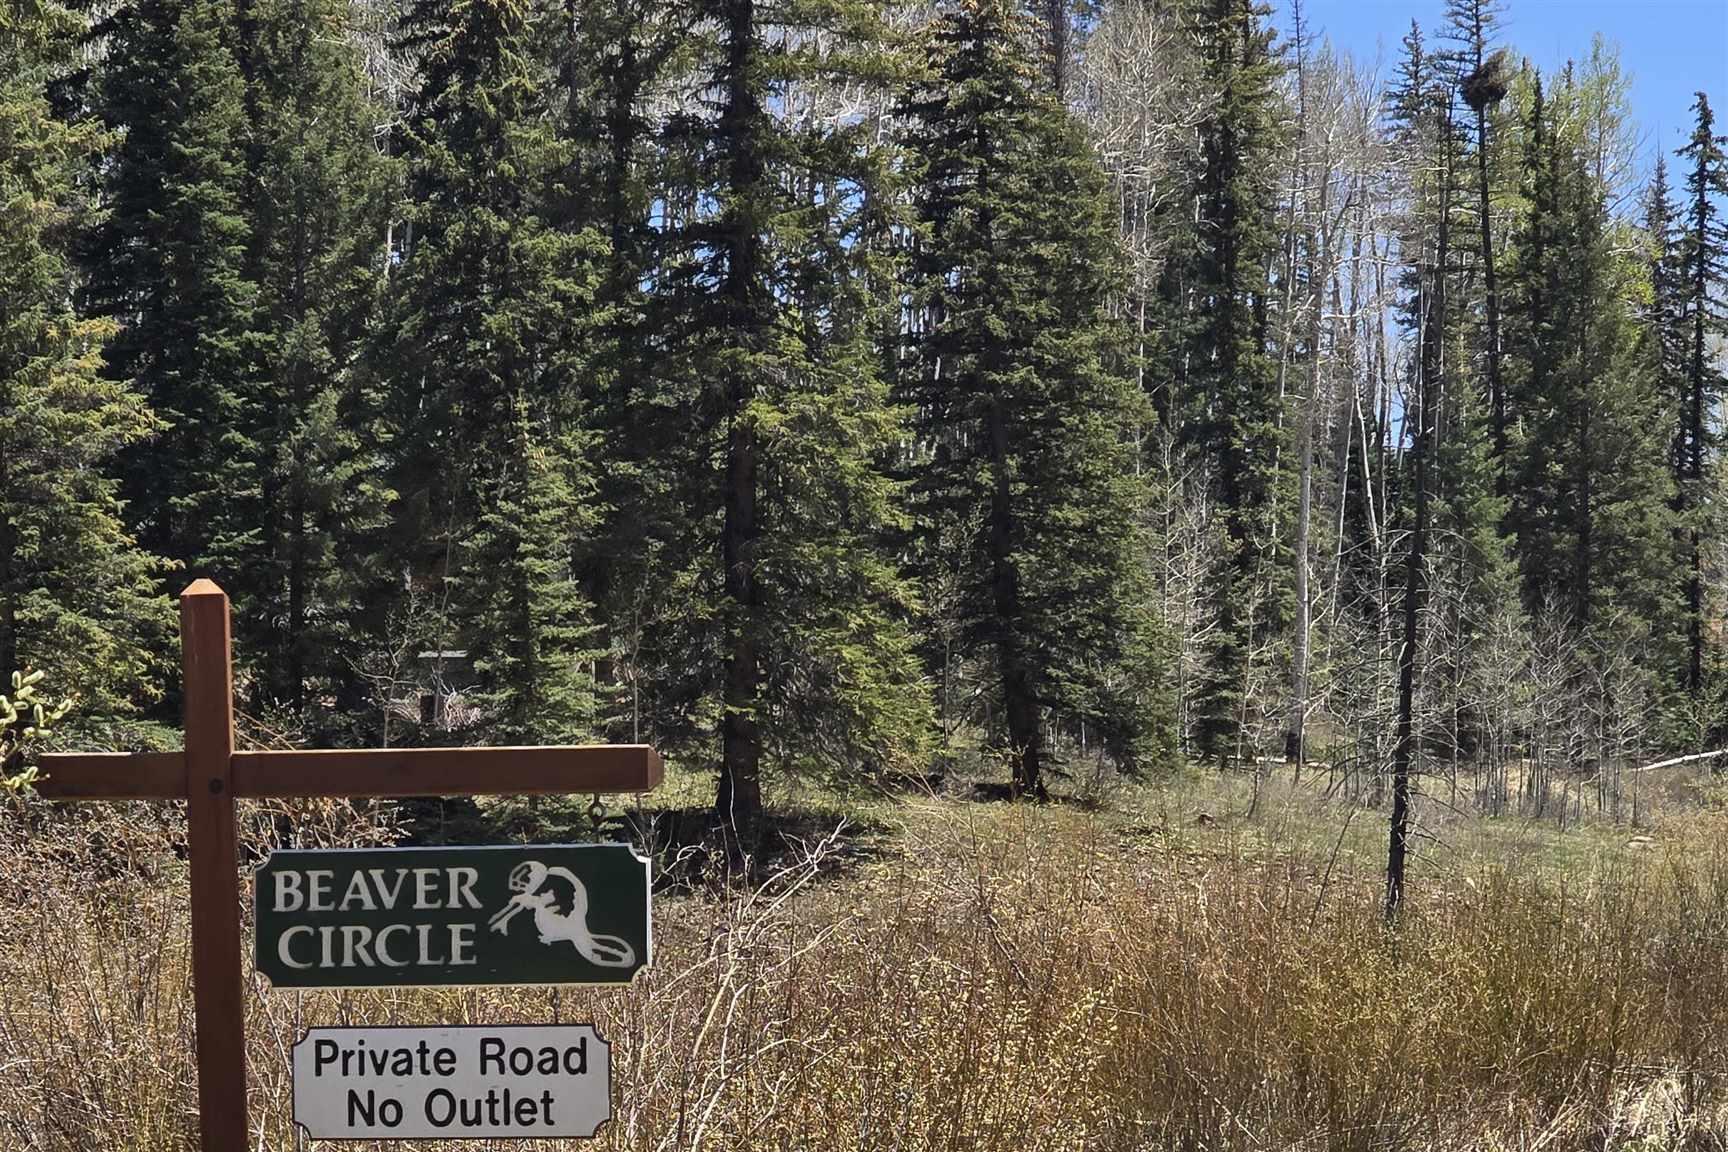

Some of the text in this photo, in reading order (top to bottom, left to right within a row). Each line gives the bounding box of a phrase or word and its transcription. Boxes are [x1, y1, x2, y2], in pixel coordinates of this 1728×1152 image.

[272, 867, 483, 912] BEAVER
[277, 924, 477, 969] CIRCLE
[314, 1037, 587, 1077] Private Road
[347, 1088, 555, 1128] No Outlet
